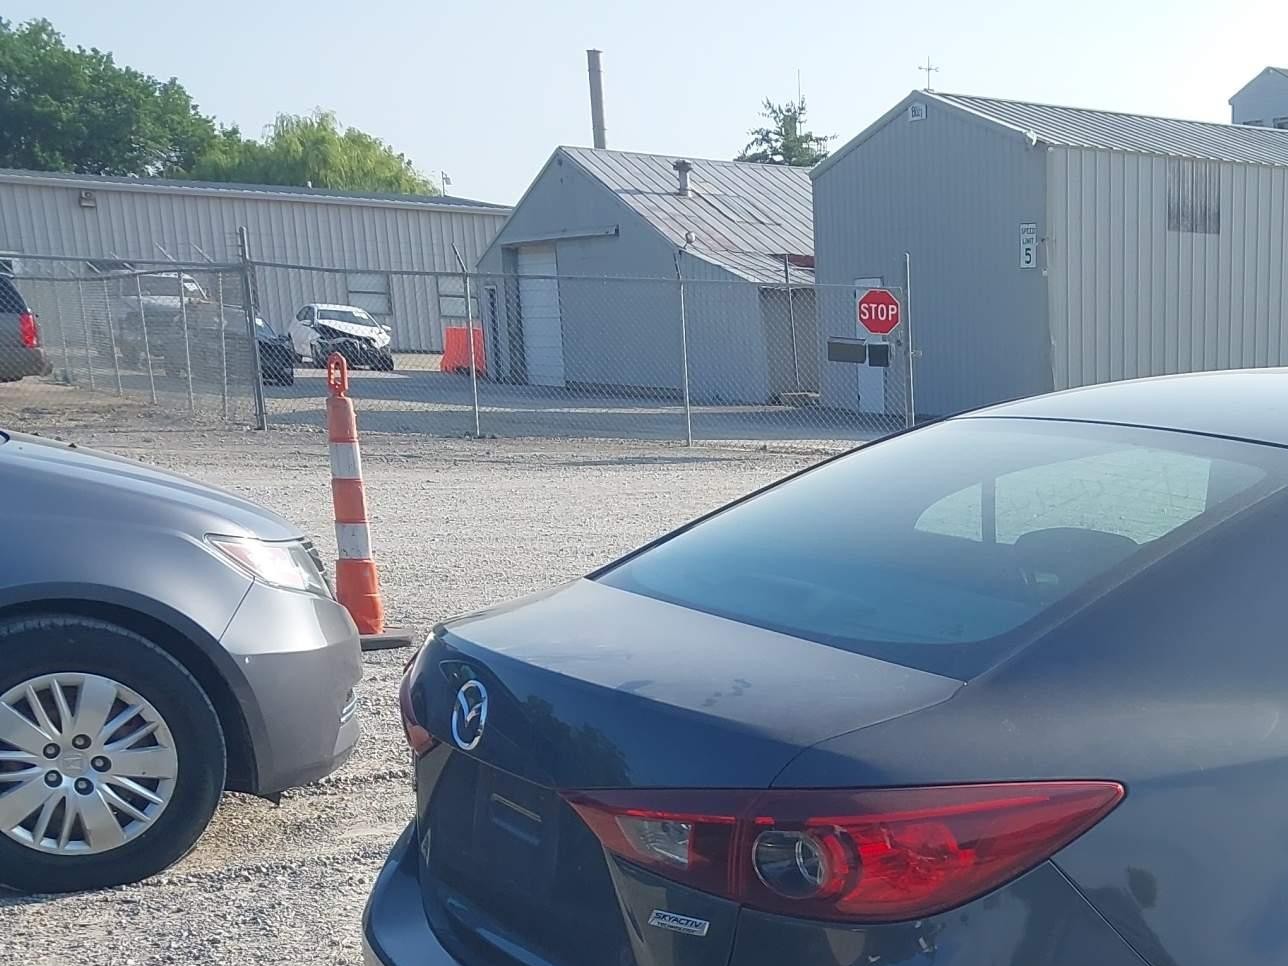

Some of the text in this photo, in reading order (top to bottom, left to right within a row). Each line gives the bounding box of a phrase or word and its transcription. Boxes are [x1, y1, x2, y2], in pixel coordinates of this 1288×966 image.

[1025, 248, 1032, 264] 5
[860, 303, 897, 321] STOP
[655, 913, 702, 928] SKYACTIV
